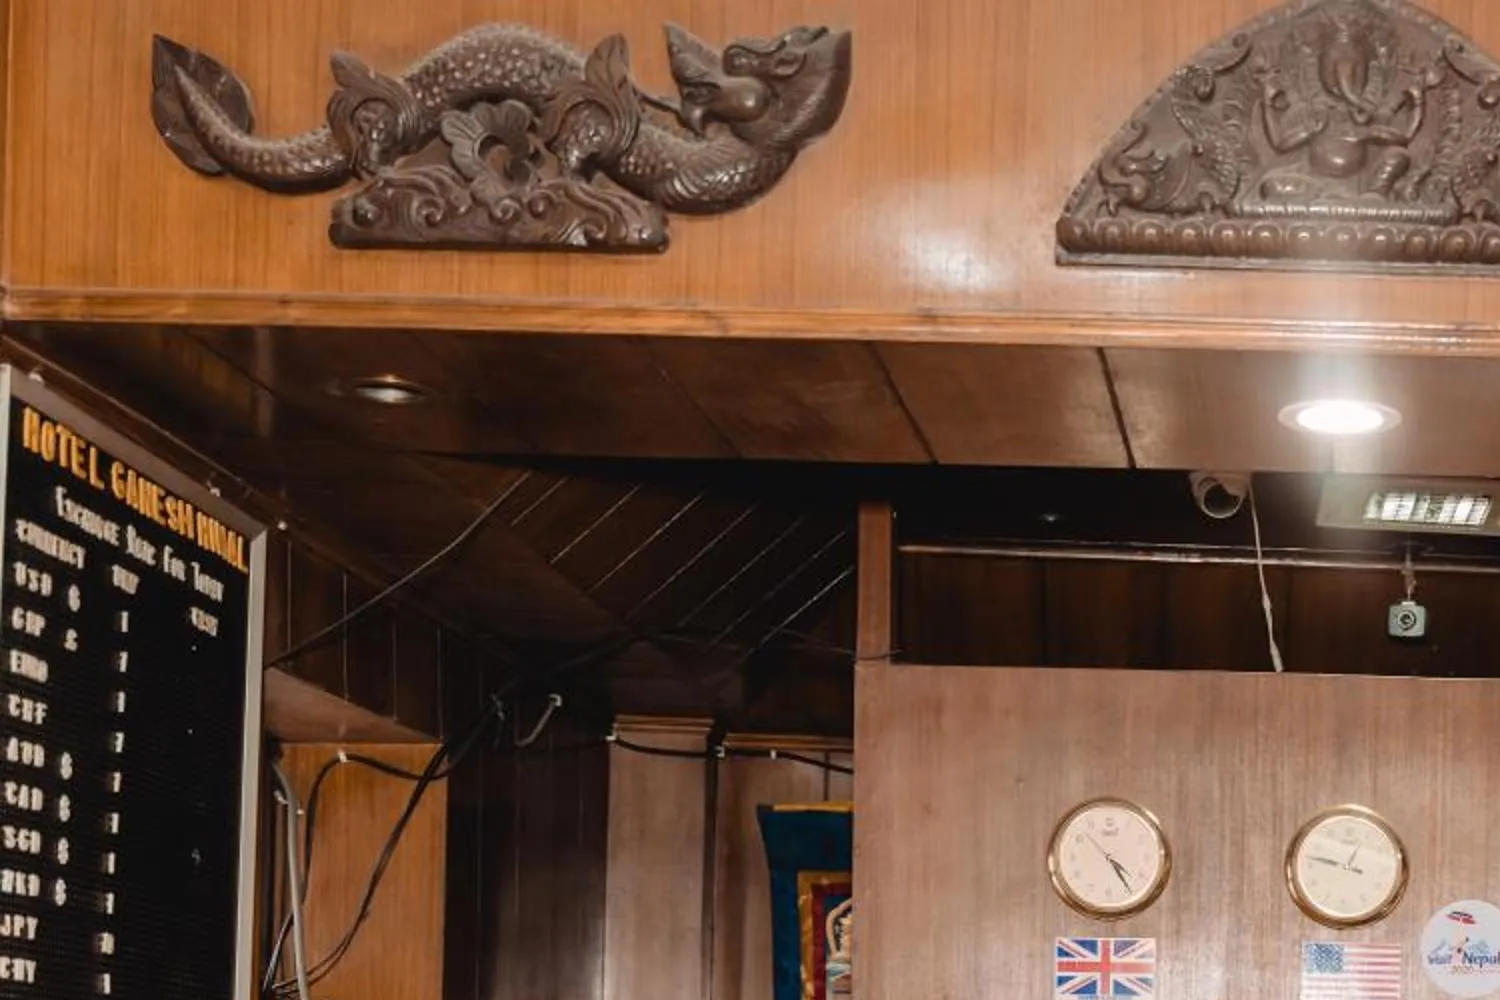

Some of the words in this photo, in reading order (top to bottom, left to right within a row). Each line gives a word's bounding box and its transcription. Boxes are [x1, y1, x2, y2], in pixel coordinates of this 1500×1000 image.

[23, 407, 104, 489] HOTEL
[111, 462, 195, 540] GANESH
[13, 561, 52, 598] USD
[10, 648, 49, 684] EURO
[8, 693, 48, 725] CHF
[6, 737, 45, 768] AUD
[4, 780, 43, 812] CAD
[2, 825, 41, 855] SGD
